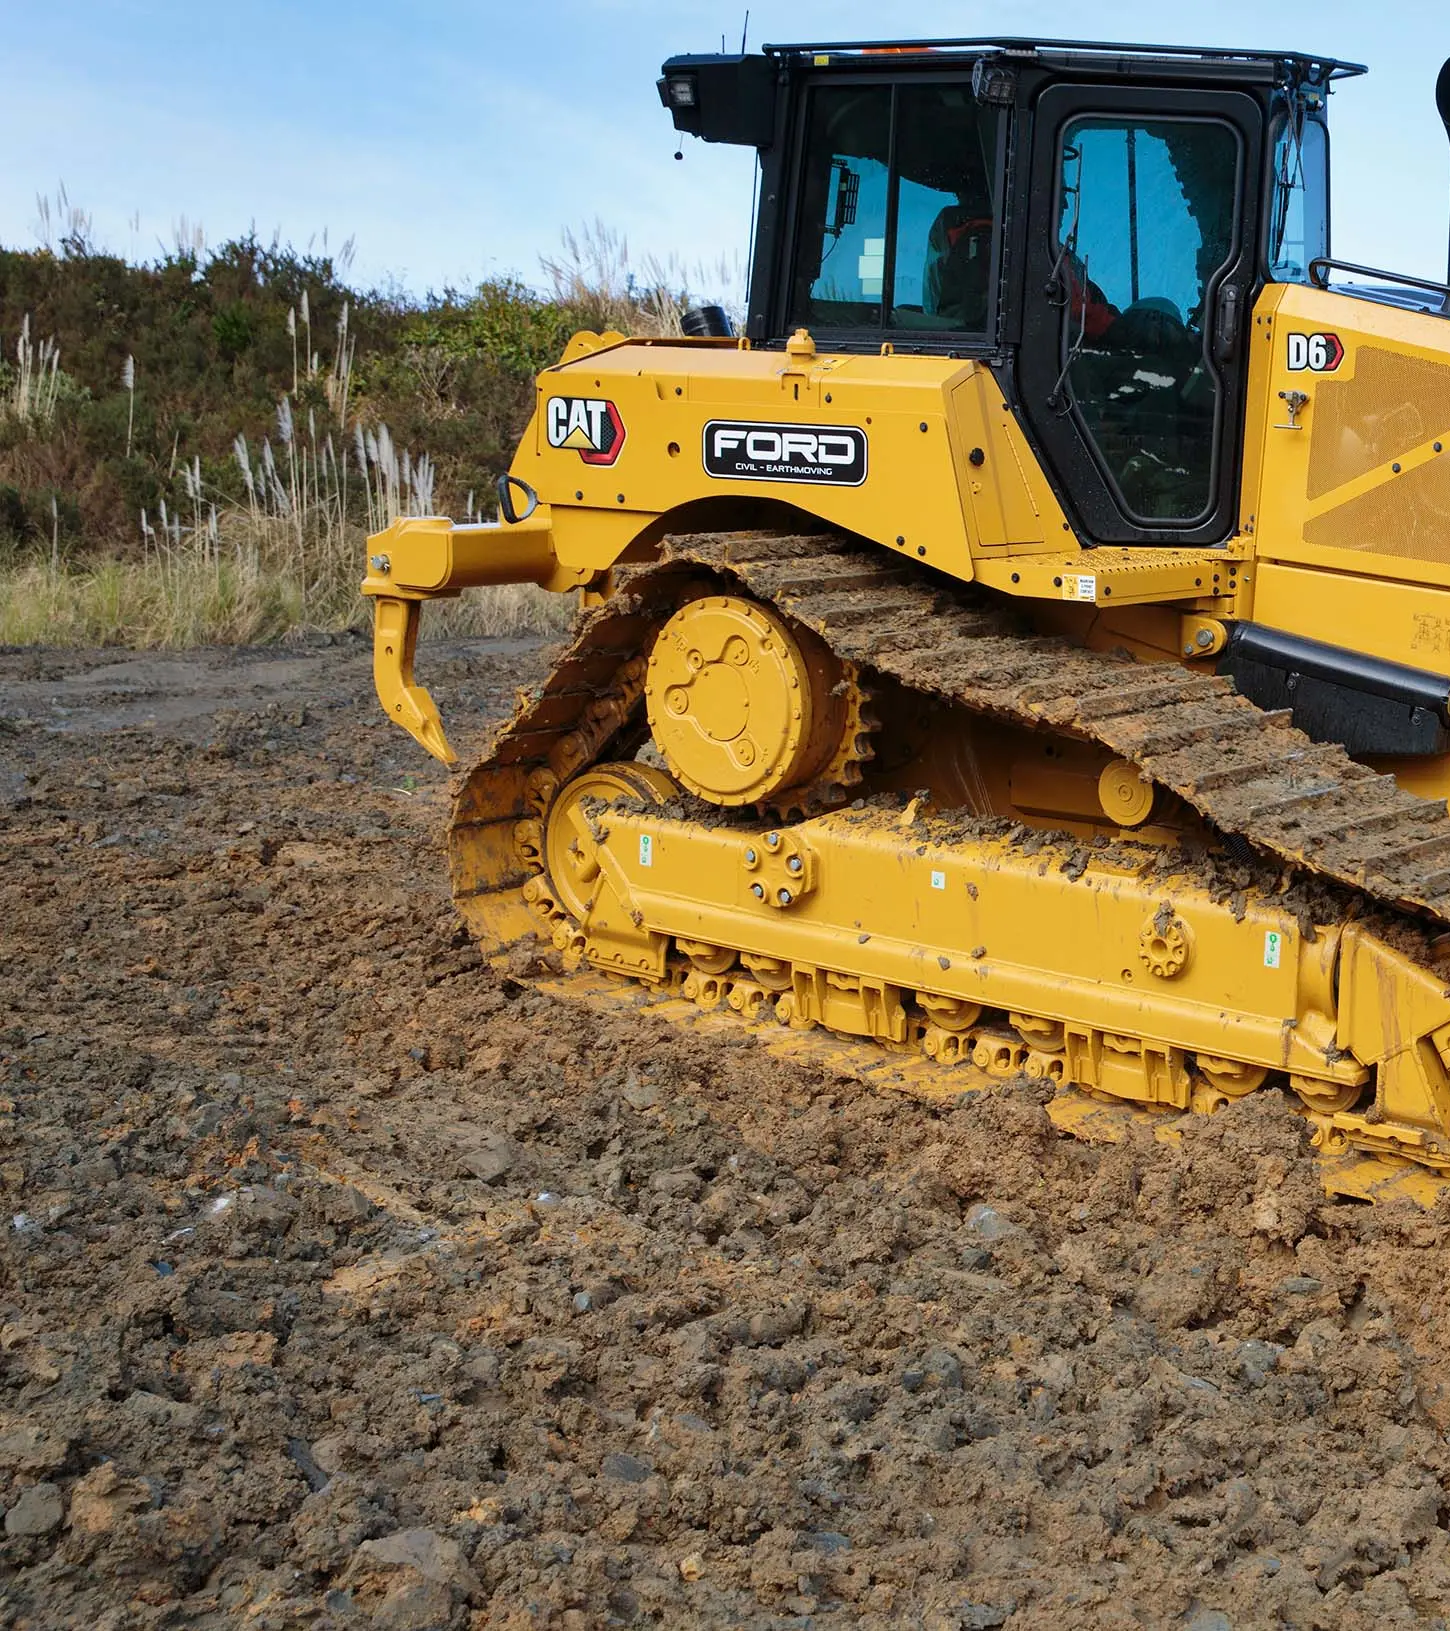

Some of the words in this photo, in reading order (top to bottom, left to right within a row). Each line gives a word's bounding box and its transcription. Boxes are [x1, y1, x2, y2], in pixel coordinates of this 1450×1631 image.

[1288, 334, 1327, 370] D6
[548, 397, 607, 450] CAT
[714, 429, 855, 465] FORD
[735, 462, 758, 471] CIVIL
[766, 464, 833, 476] EARTHMOVING
